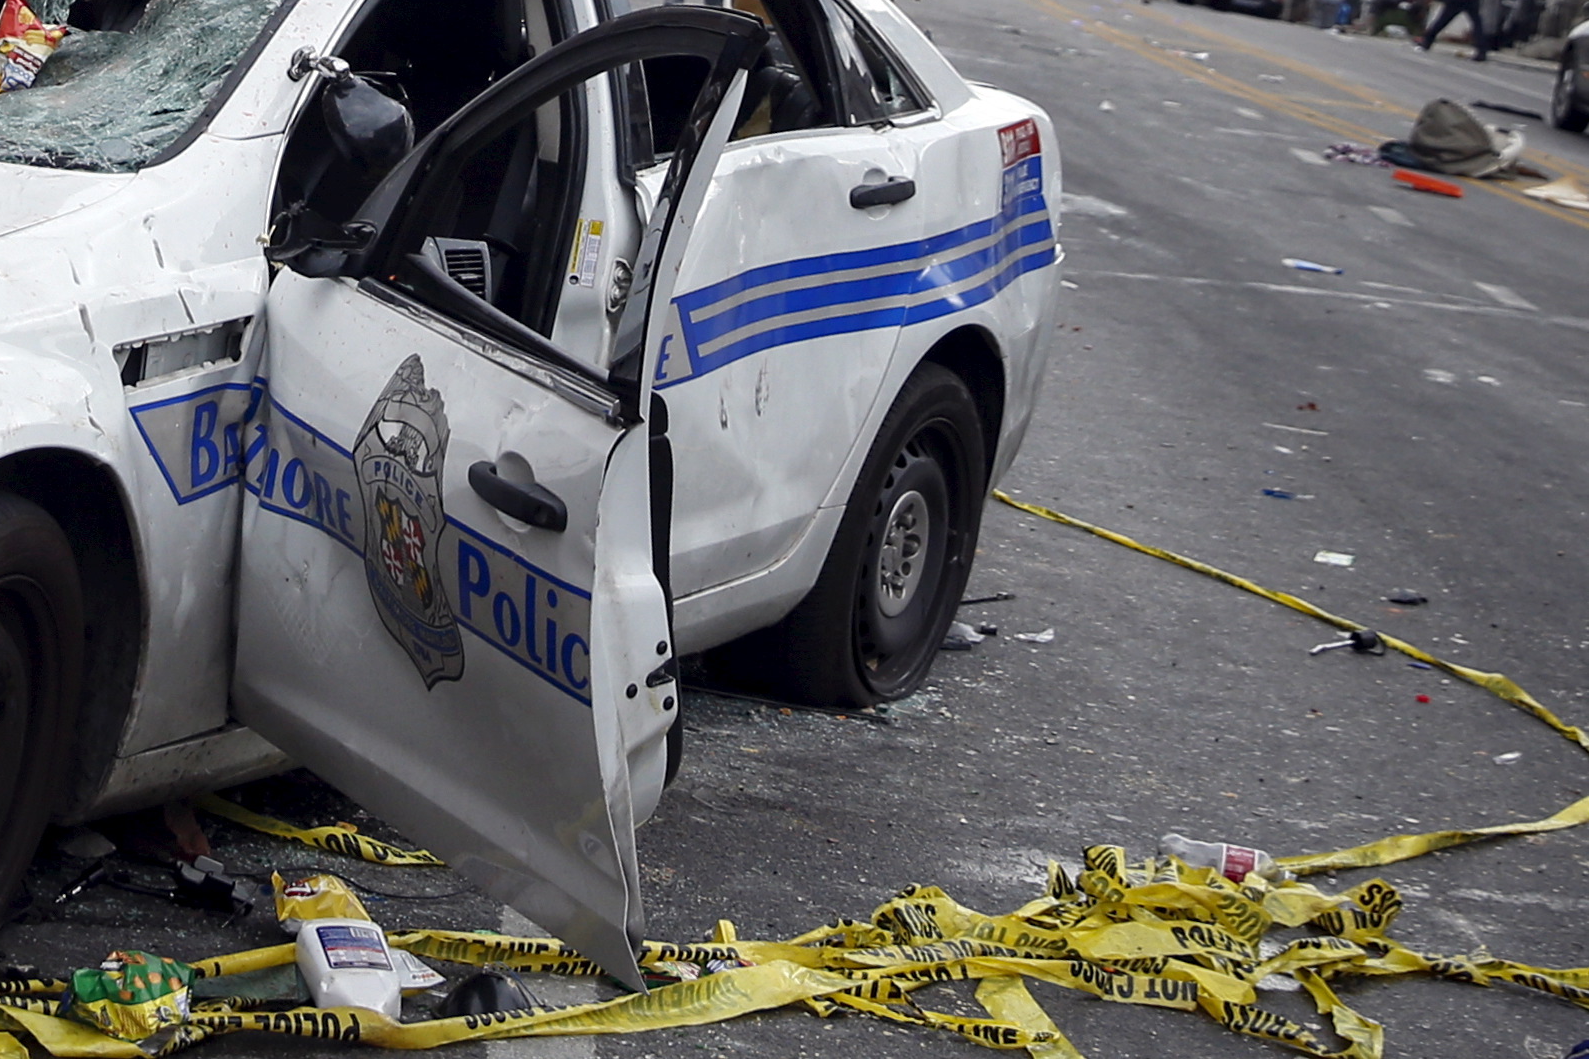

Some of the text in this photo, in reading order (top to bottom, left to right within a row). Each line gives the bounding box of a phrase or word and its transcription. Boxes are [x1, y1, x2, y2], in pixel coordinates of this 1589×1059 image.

[655, 334, 674, 381] E
[374, 460, 425, 511] POLICE
[1143, 977, 1199, 1002] NOT
